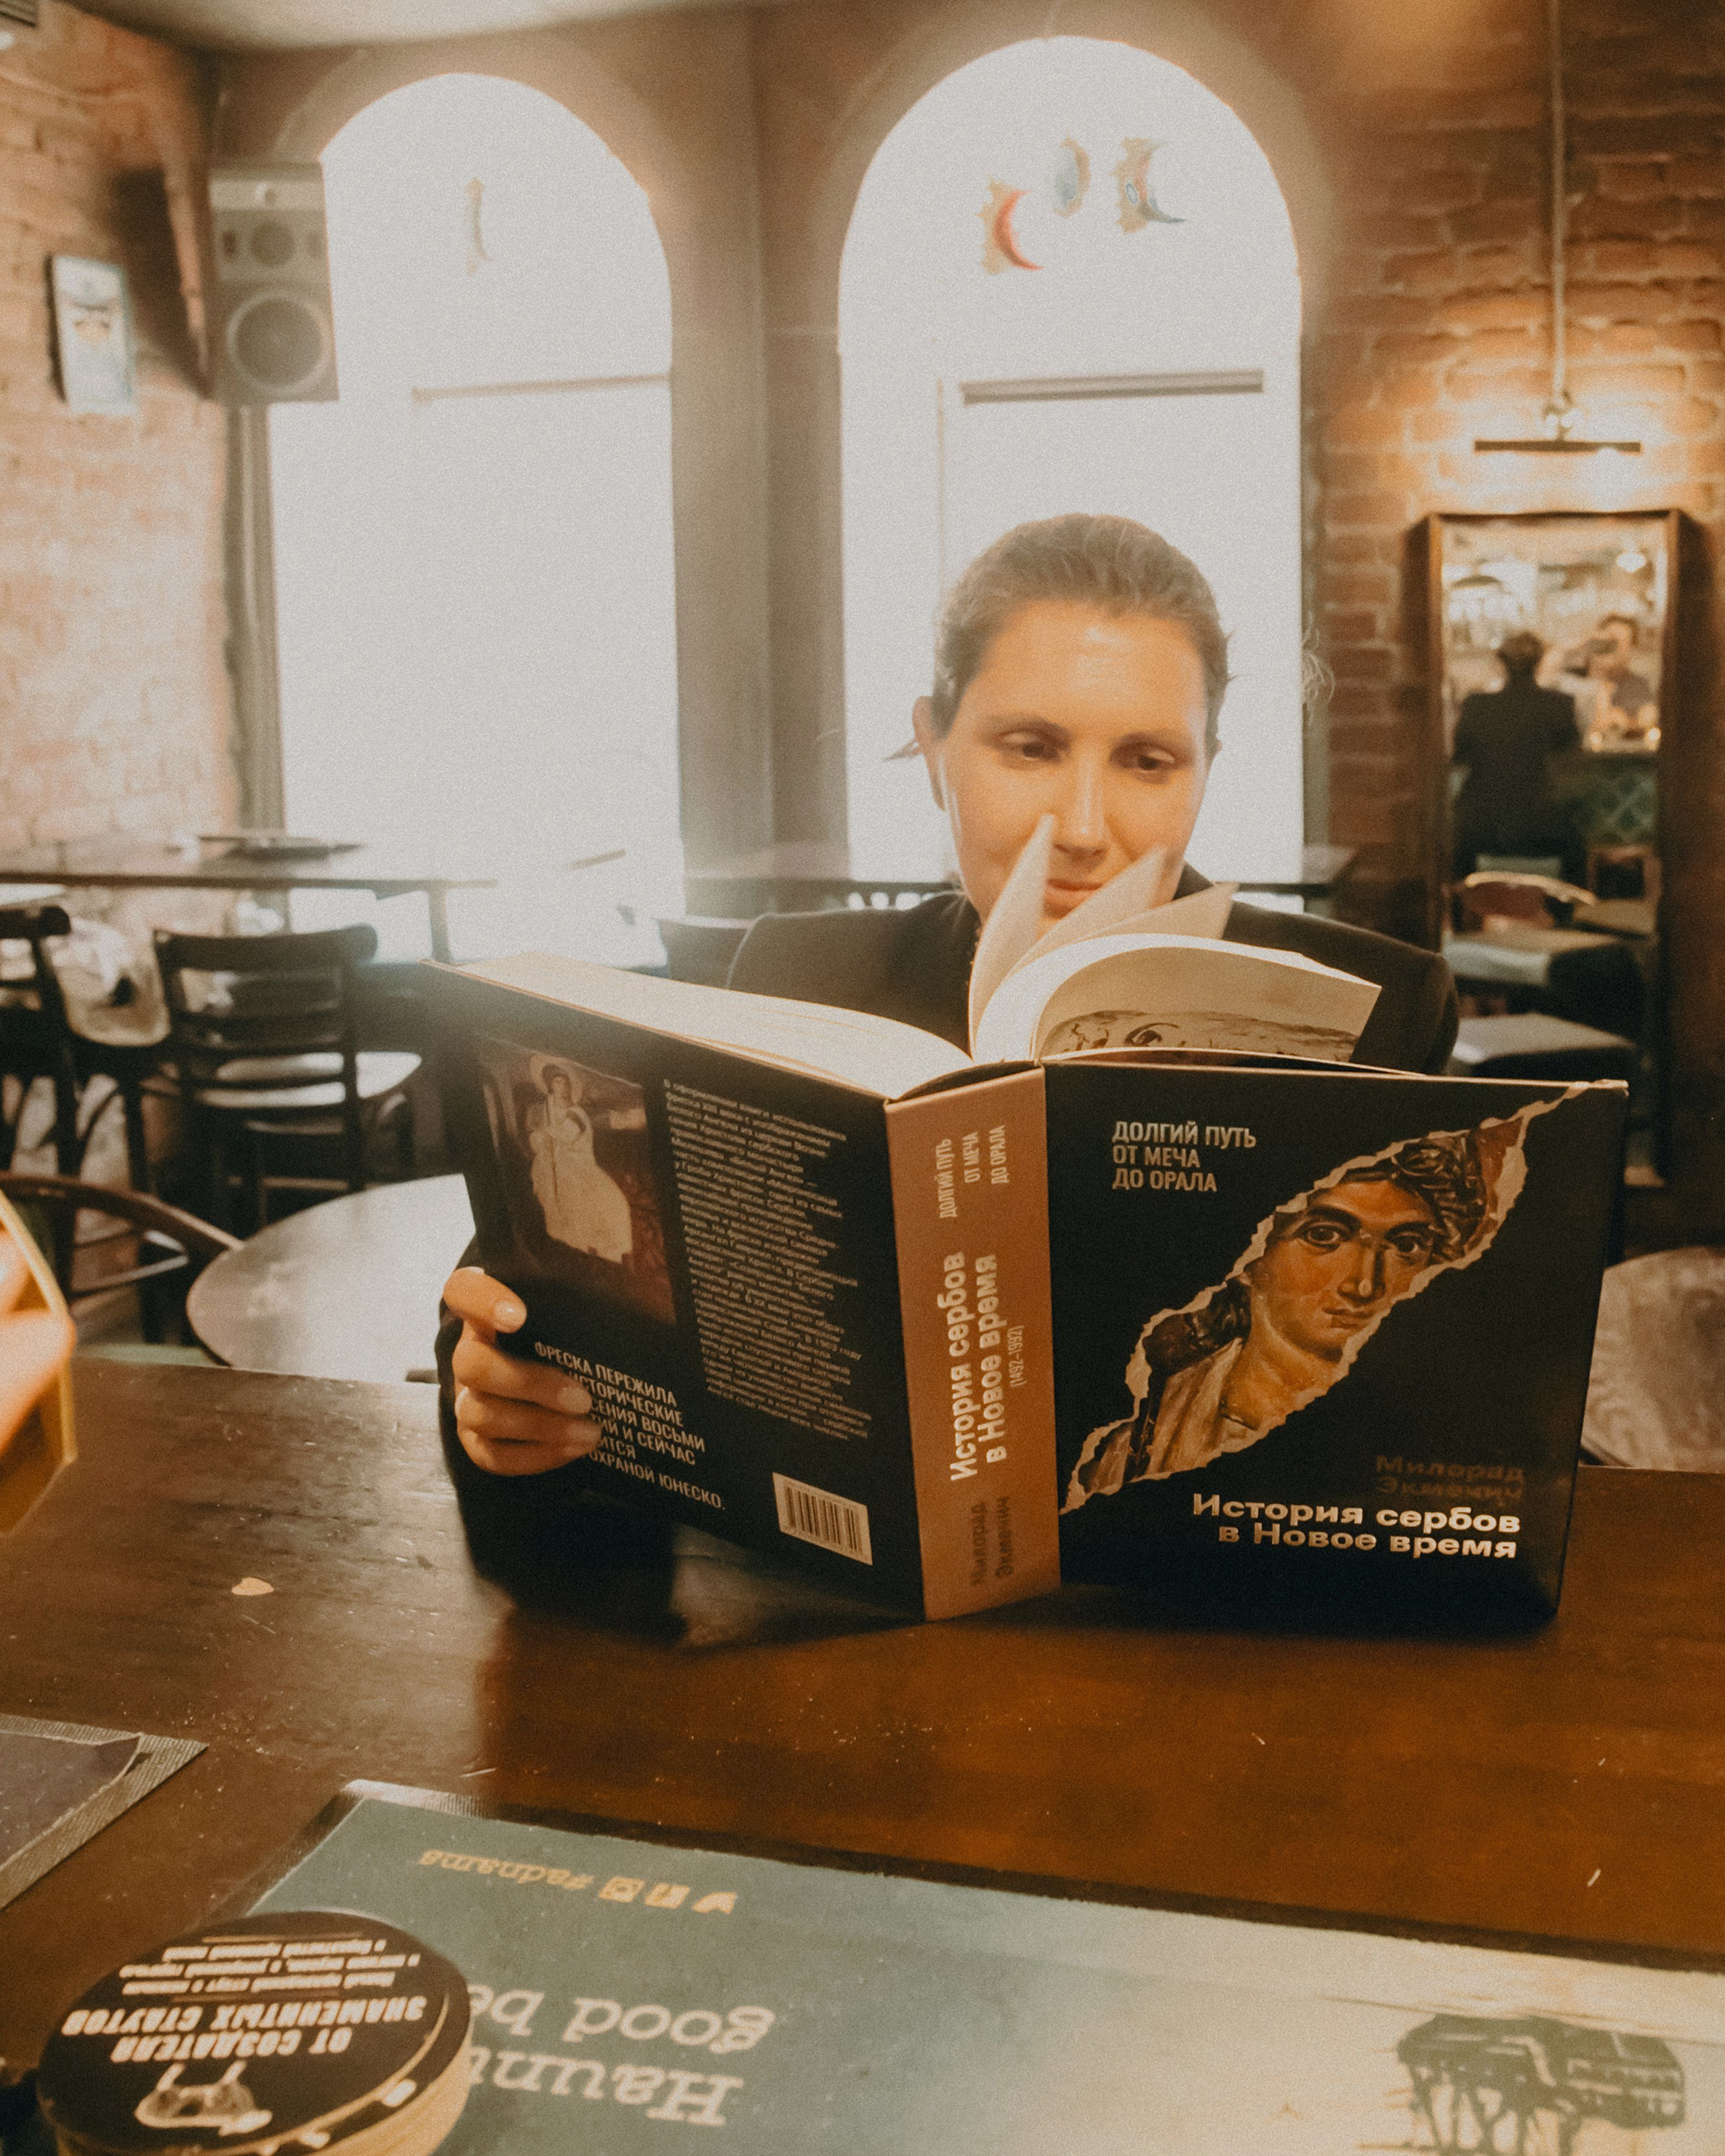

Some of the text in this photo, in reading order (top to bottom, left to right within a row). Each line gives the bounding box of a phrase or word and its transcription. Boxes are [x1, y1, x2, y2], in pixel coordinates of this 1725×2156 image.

[989, 1124, 1009, 1184] ДО ОРАЛА
[1112, 1120, 1257, 1149] ДОЛГИЙ ПУТЬ
[962, 1131, 980, 1183] ОТ МЕЧА
[1112, 1145, 1201, 1168] ОТ МЕЧА
[934, 1138, 958, 1218] ДОЛГИЙ ПУТЬ
[1112, 1168, 1218, 1192] ДО ОРАЛА
[534, 1341, 593, 1376] ФРЕСКА
[594, 1363, 678, 1408] ПЕРЕЖИЛА
[937, 1251, 981, 1481] История сербов
[975, 1254, 1007, 1463] в Новое время
[622, 1425, 634, 1442] И
[637, 1431, 696, 1465] СЕЙЧАС
[641, 1415, 705, 1453] ВОСЬМИ
[1375, 1454, 1525, 1484] Милорад
[658, 1472, 726, 1511] ЮНЕСКО.
[1193, 1493, 1521, 1534] История сербов
[1218, 1522, 1517, 1558] в Новое время
[418, 1849, 596, 1890] #adnams
[61, 1996, 427, 2036] ЗНАМЕНИТЫХ СТАУТОВ
[466, 1984, 776, 2054] good be
[110, 2026, 352, 2063] ОТ СОЗДАТЕЛЯ
[469, 2045, 745, 2127] Haunt
